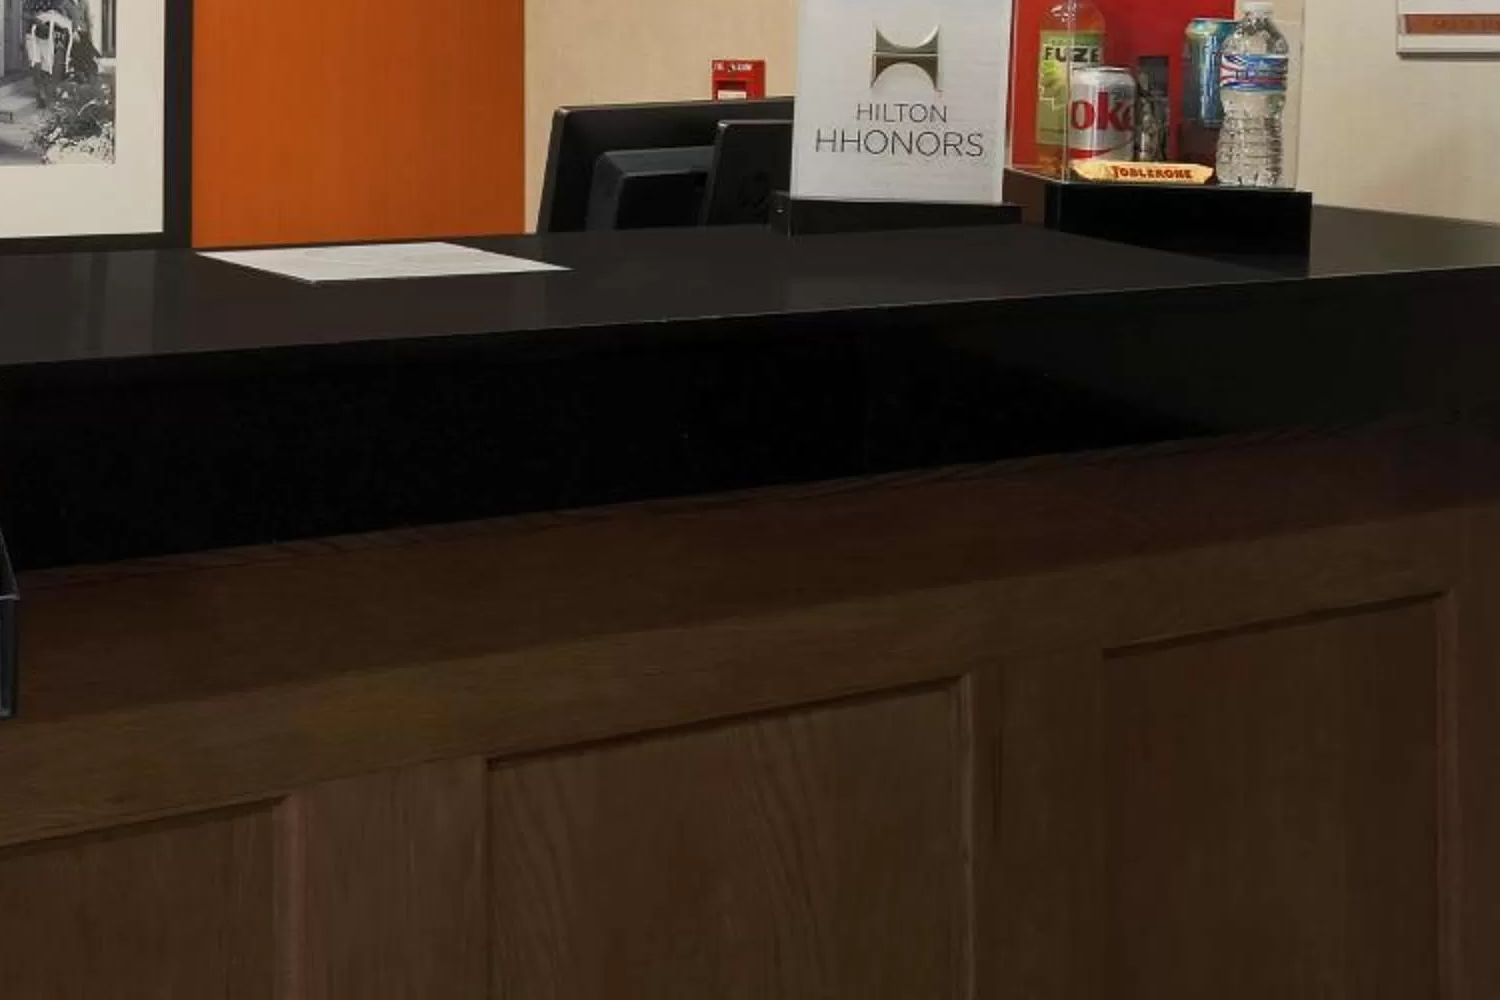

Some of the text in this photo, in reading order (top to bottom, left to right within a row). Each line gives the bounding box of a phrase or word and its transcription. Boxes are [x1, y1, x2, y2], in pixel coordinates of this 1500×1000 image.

[1043, 46, 1102, 63] FUZE
[856, 102, 948, 123] HILTON
[815, 128, 984, 157] HHONORS
[1110, 164, 1193, 179] TOBLERONE
